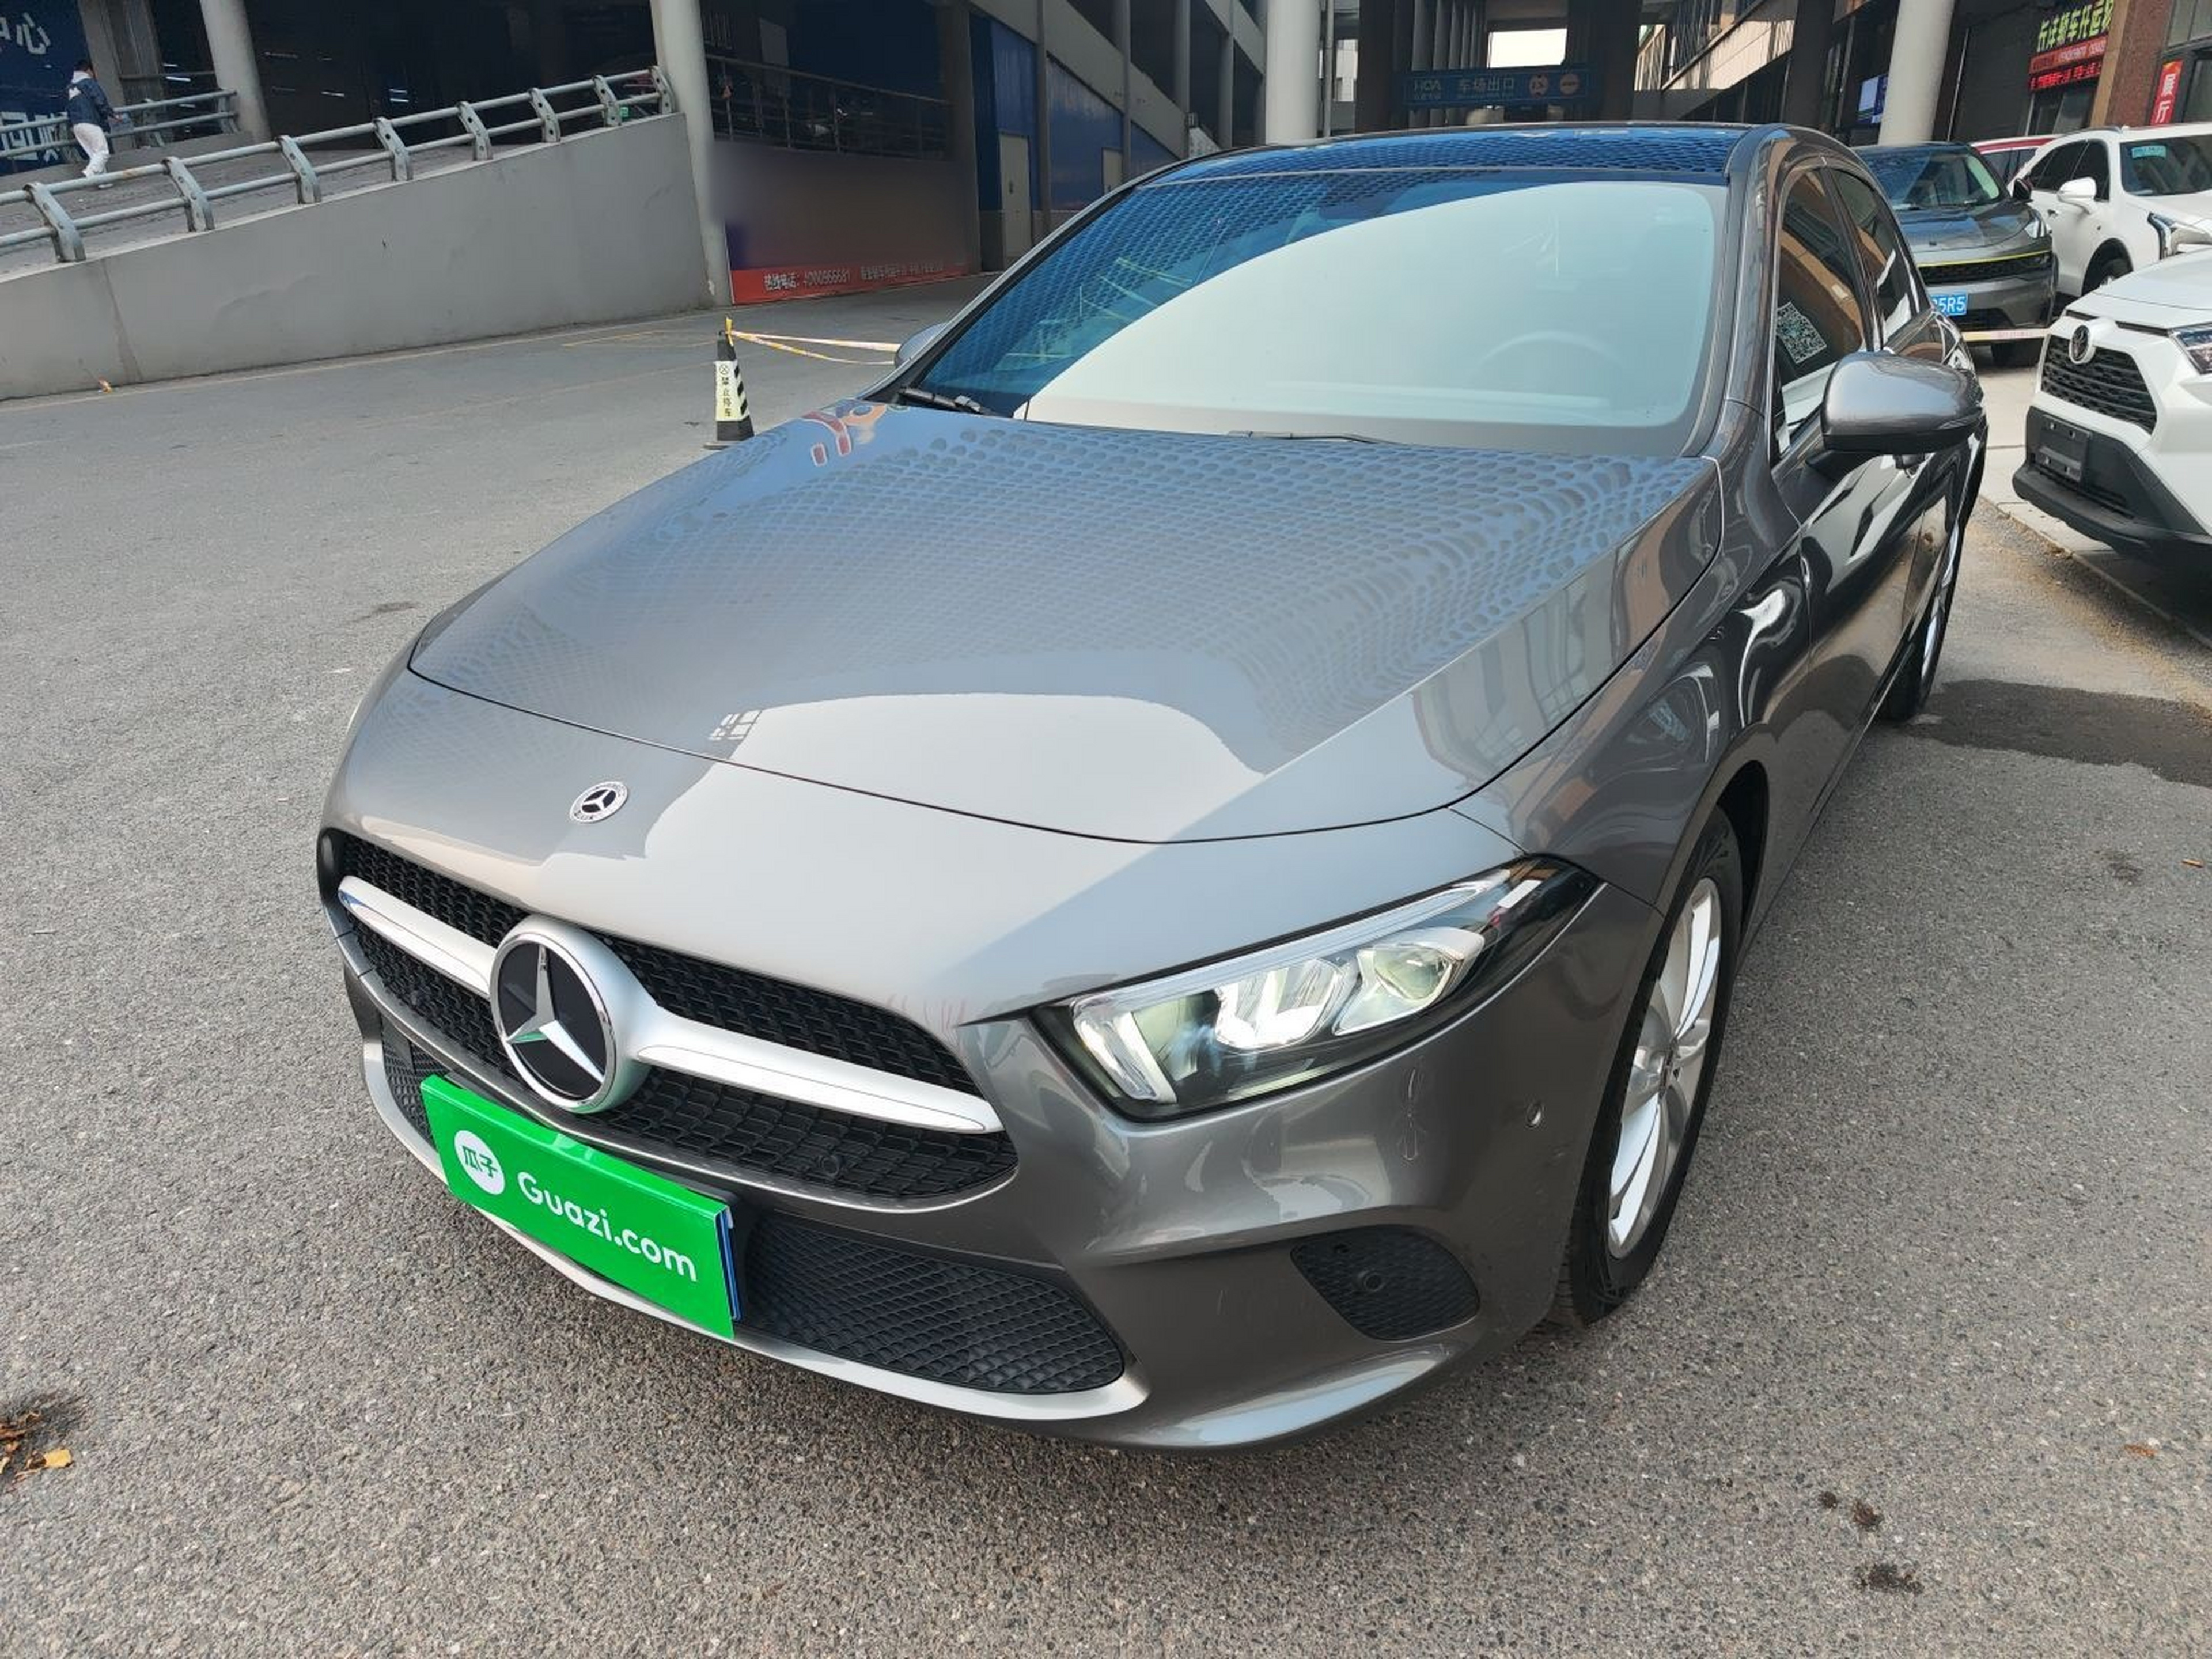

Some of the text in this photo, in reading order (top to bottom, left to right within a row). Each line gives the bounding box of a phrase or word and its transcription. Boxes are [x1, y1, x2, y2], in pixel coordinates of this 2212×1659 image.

[2155, 73, 2176, 123] 展厅
[461, 1145, 499, 1179] 瓜子
[518, 1171, 698, 1282] Guazi.com
